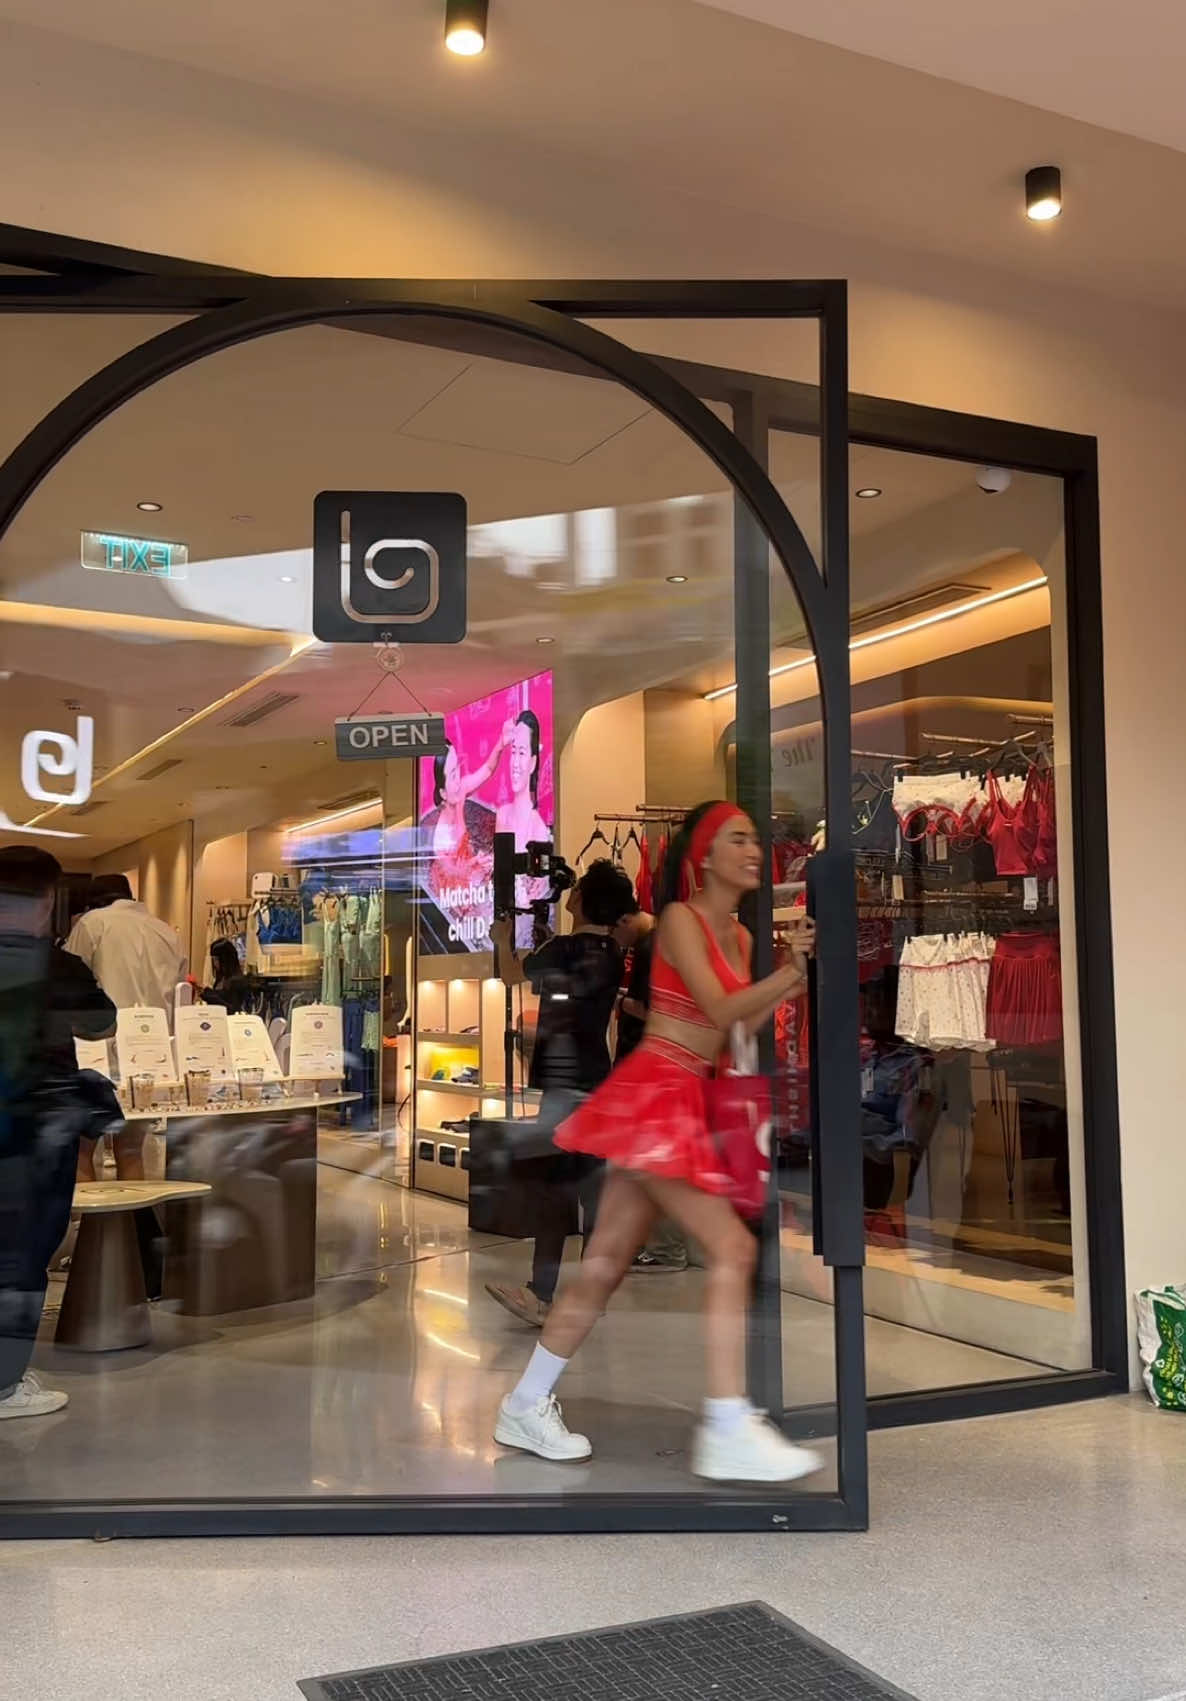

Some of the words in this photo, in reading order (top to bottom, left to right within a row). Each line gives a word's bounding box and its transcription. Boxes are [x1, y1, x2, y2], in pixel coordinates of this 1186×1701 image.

[349, 723, 429, 748] OPEN
[439, 881, 485, 909] Matcha
[448, 916, 475, 942] chill
